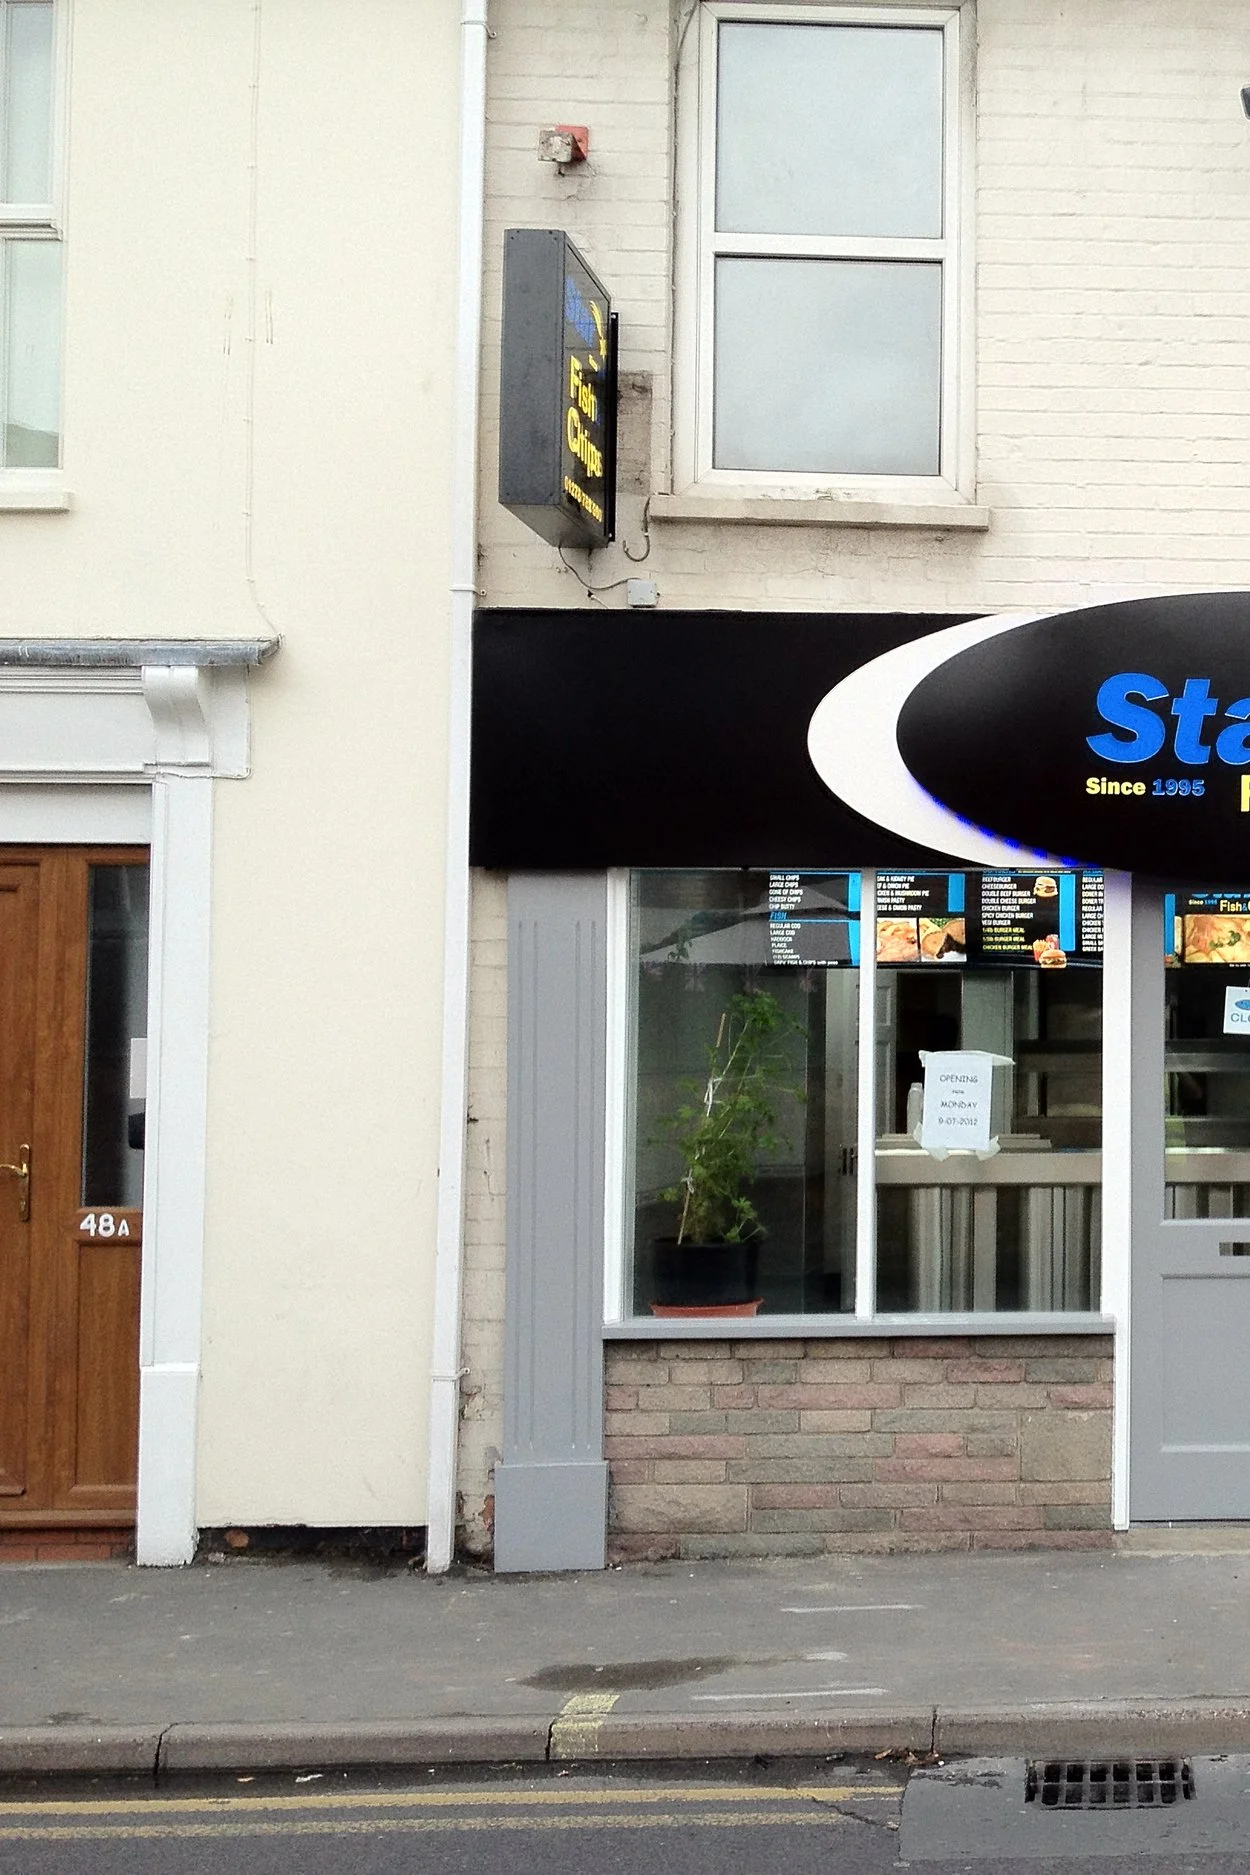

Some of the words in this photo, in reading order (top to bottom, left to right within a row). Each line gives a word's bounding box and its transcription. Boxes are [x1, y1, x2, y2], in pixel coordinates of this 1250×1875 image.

[569, 354, 599, 422] Fish
[567, 406, 604, 479] Chips
[1086, 777, 1146, 796] Since
[1151, 778, 1206, 797] 1995
[770, 912, 787, 920] FISH
[939, 1074, 978, 1083] OPENING
[940, 1100, 978, 1109] MONDAY
